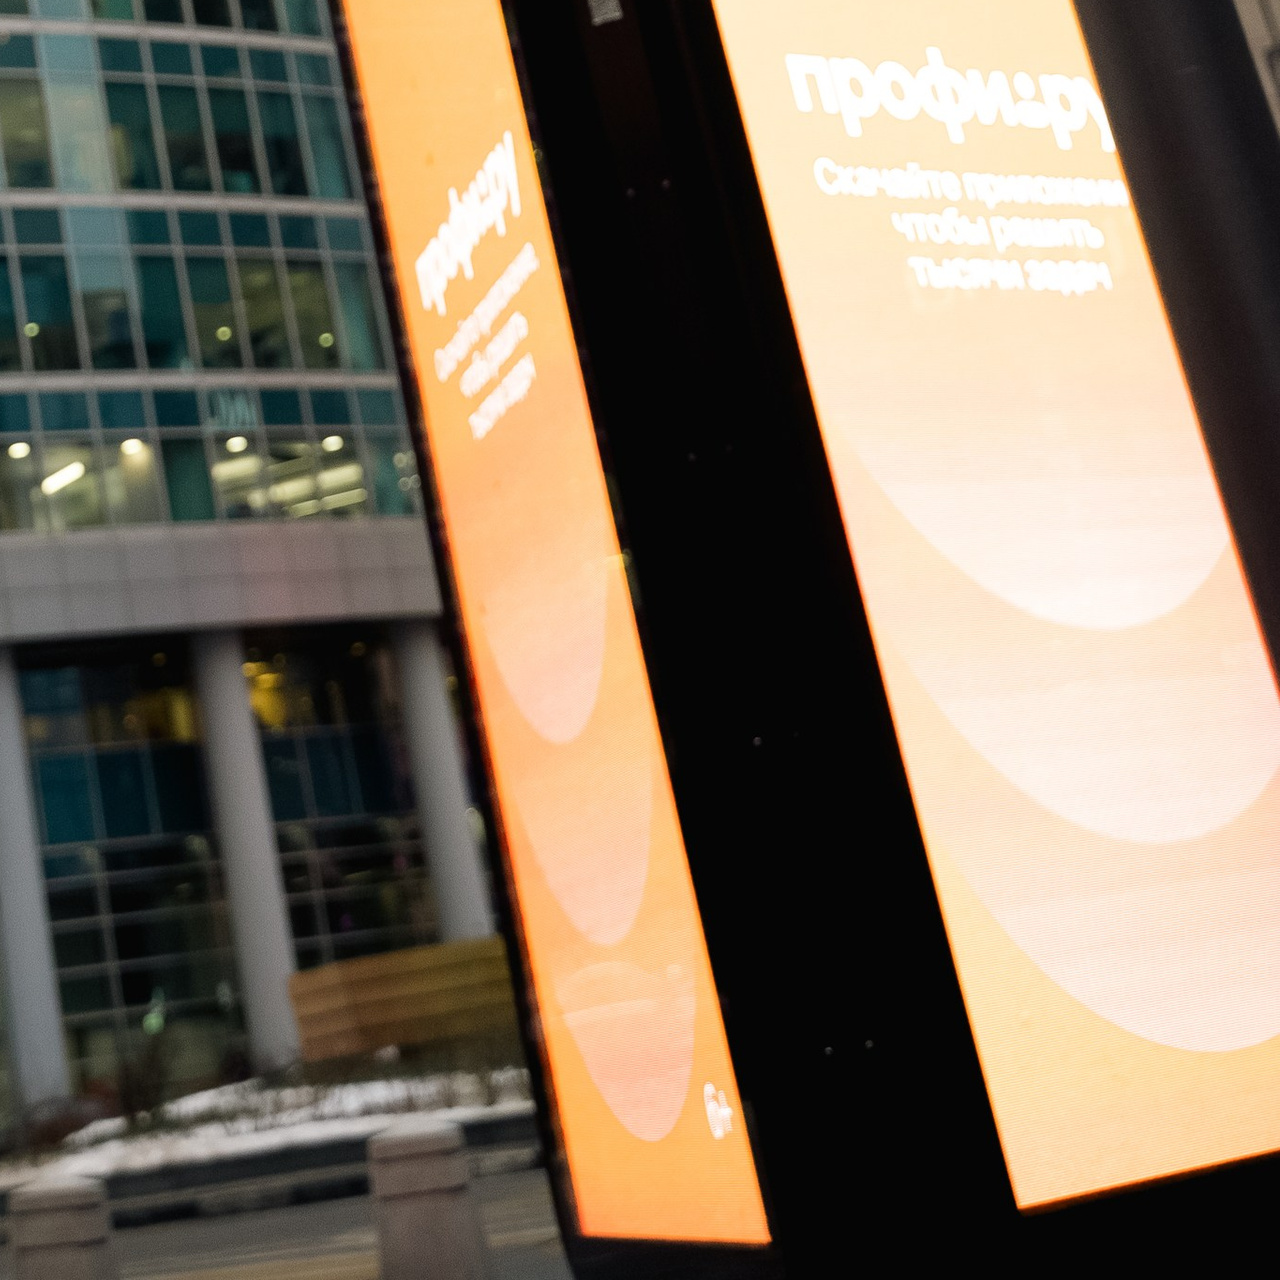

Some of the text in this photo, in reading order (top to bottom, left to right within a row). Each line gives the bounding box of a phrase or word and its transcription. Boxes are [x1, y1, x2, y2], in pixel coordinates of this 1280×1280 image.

[814, 157, 1129, 208] Скачайте приложени
[892, 207, 990, 244] чтобы
